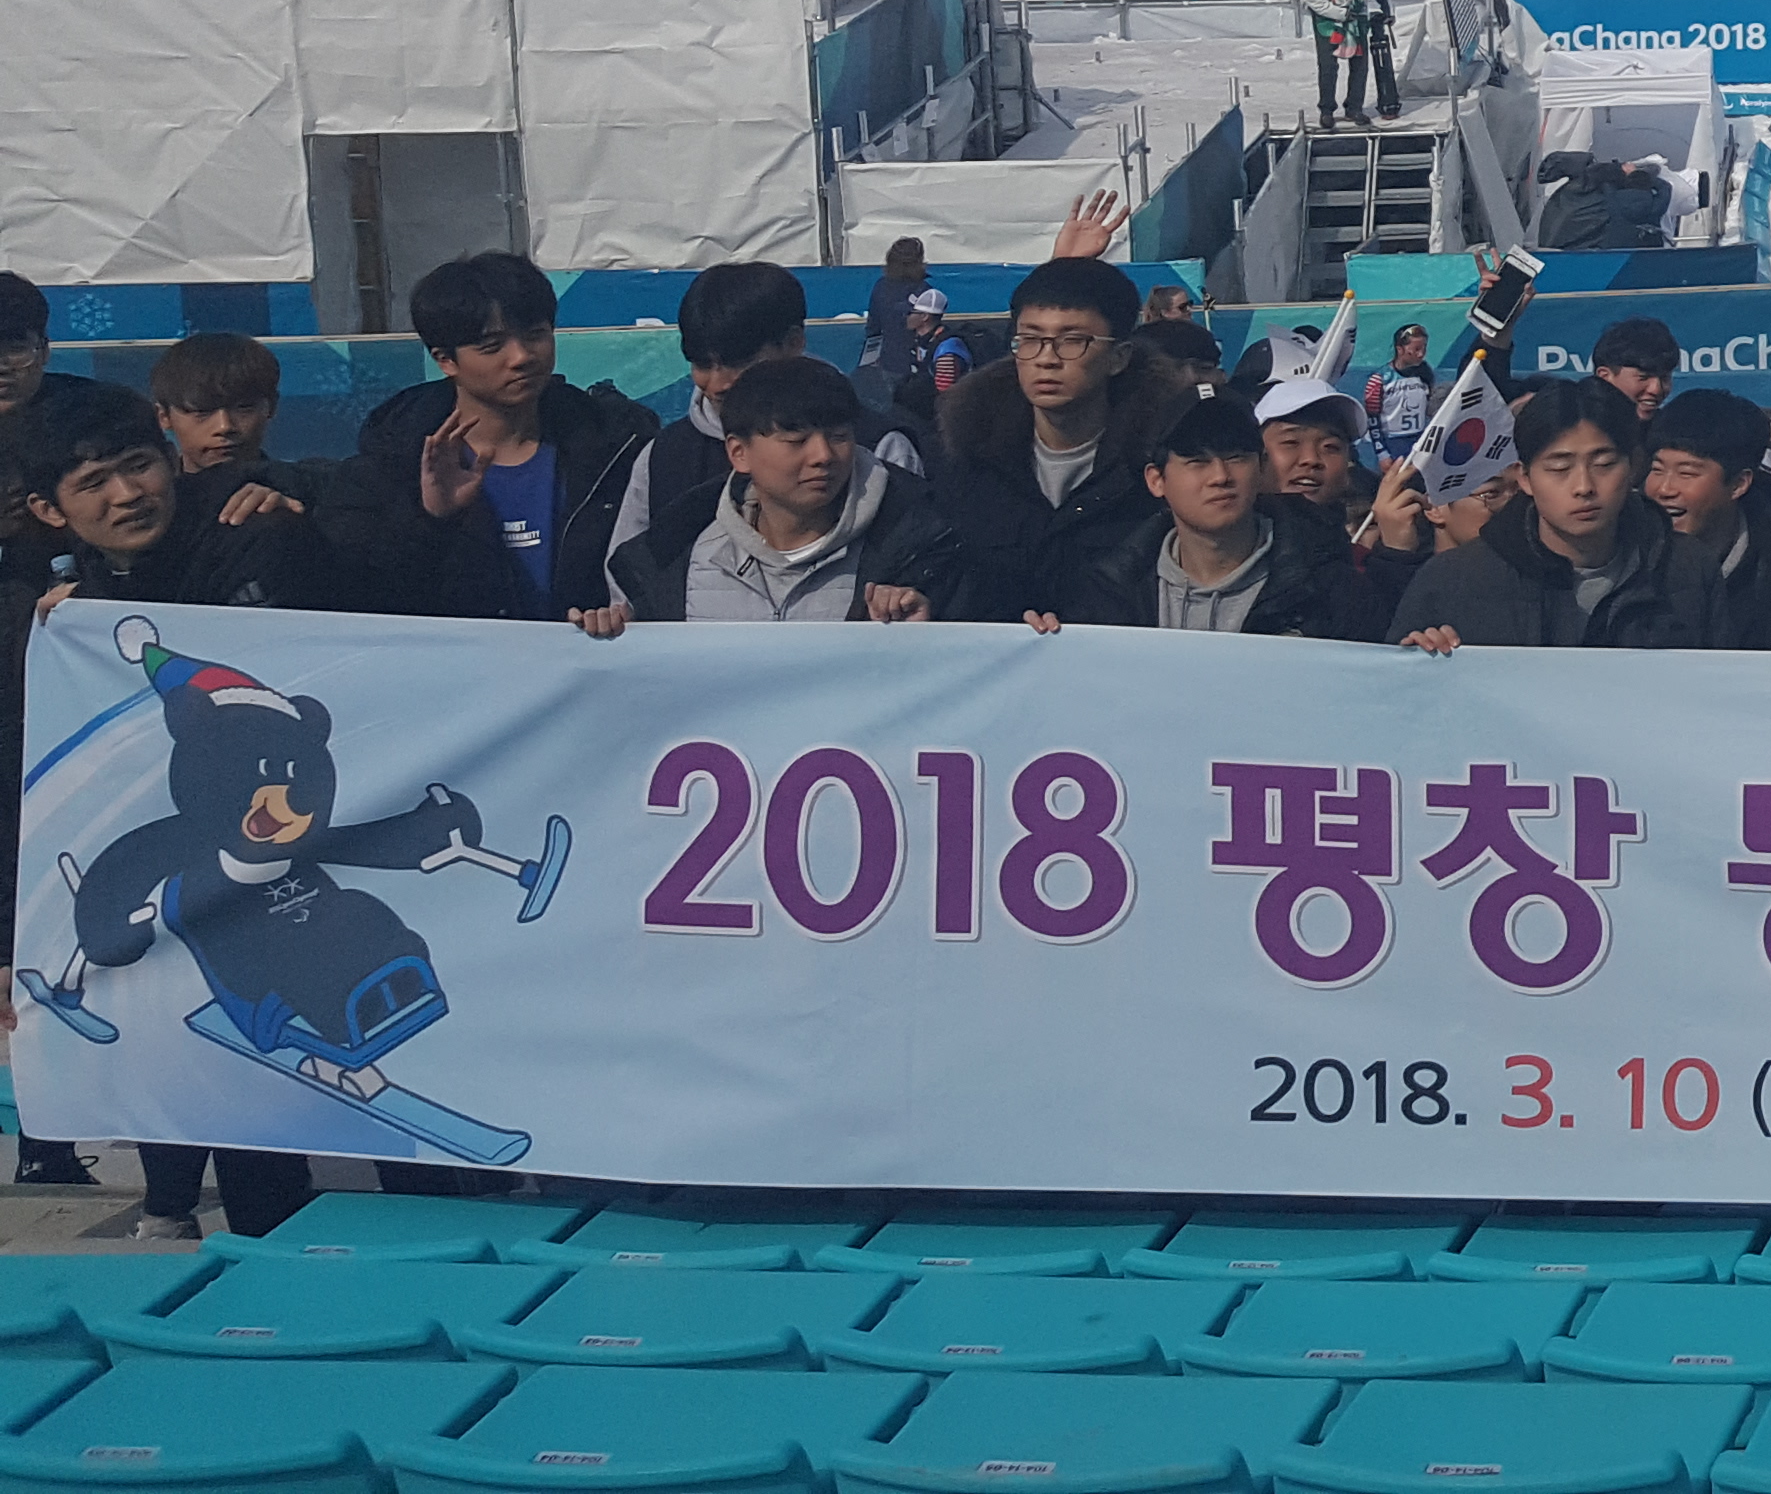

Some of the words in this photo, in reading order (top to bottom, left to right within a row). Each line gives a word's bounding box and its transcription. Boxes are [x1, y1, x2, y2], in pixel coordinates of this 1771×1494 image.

[1687, 23, 1768, 50] 2018
[1402, 415, 1420, 432] 51
[644, 741, 1130, 940] 2018
[1210, 761, 1639, 990] 평창
[1251, 1056, 1469, 1128] 2018.
[1501, 1053, 1576, 1130] 3.
[1619, 1055, 1720, 1133] 10
